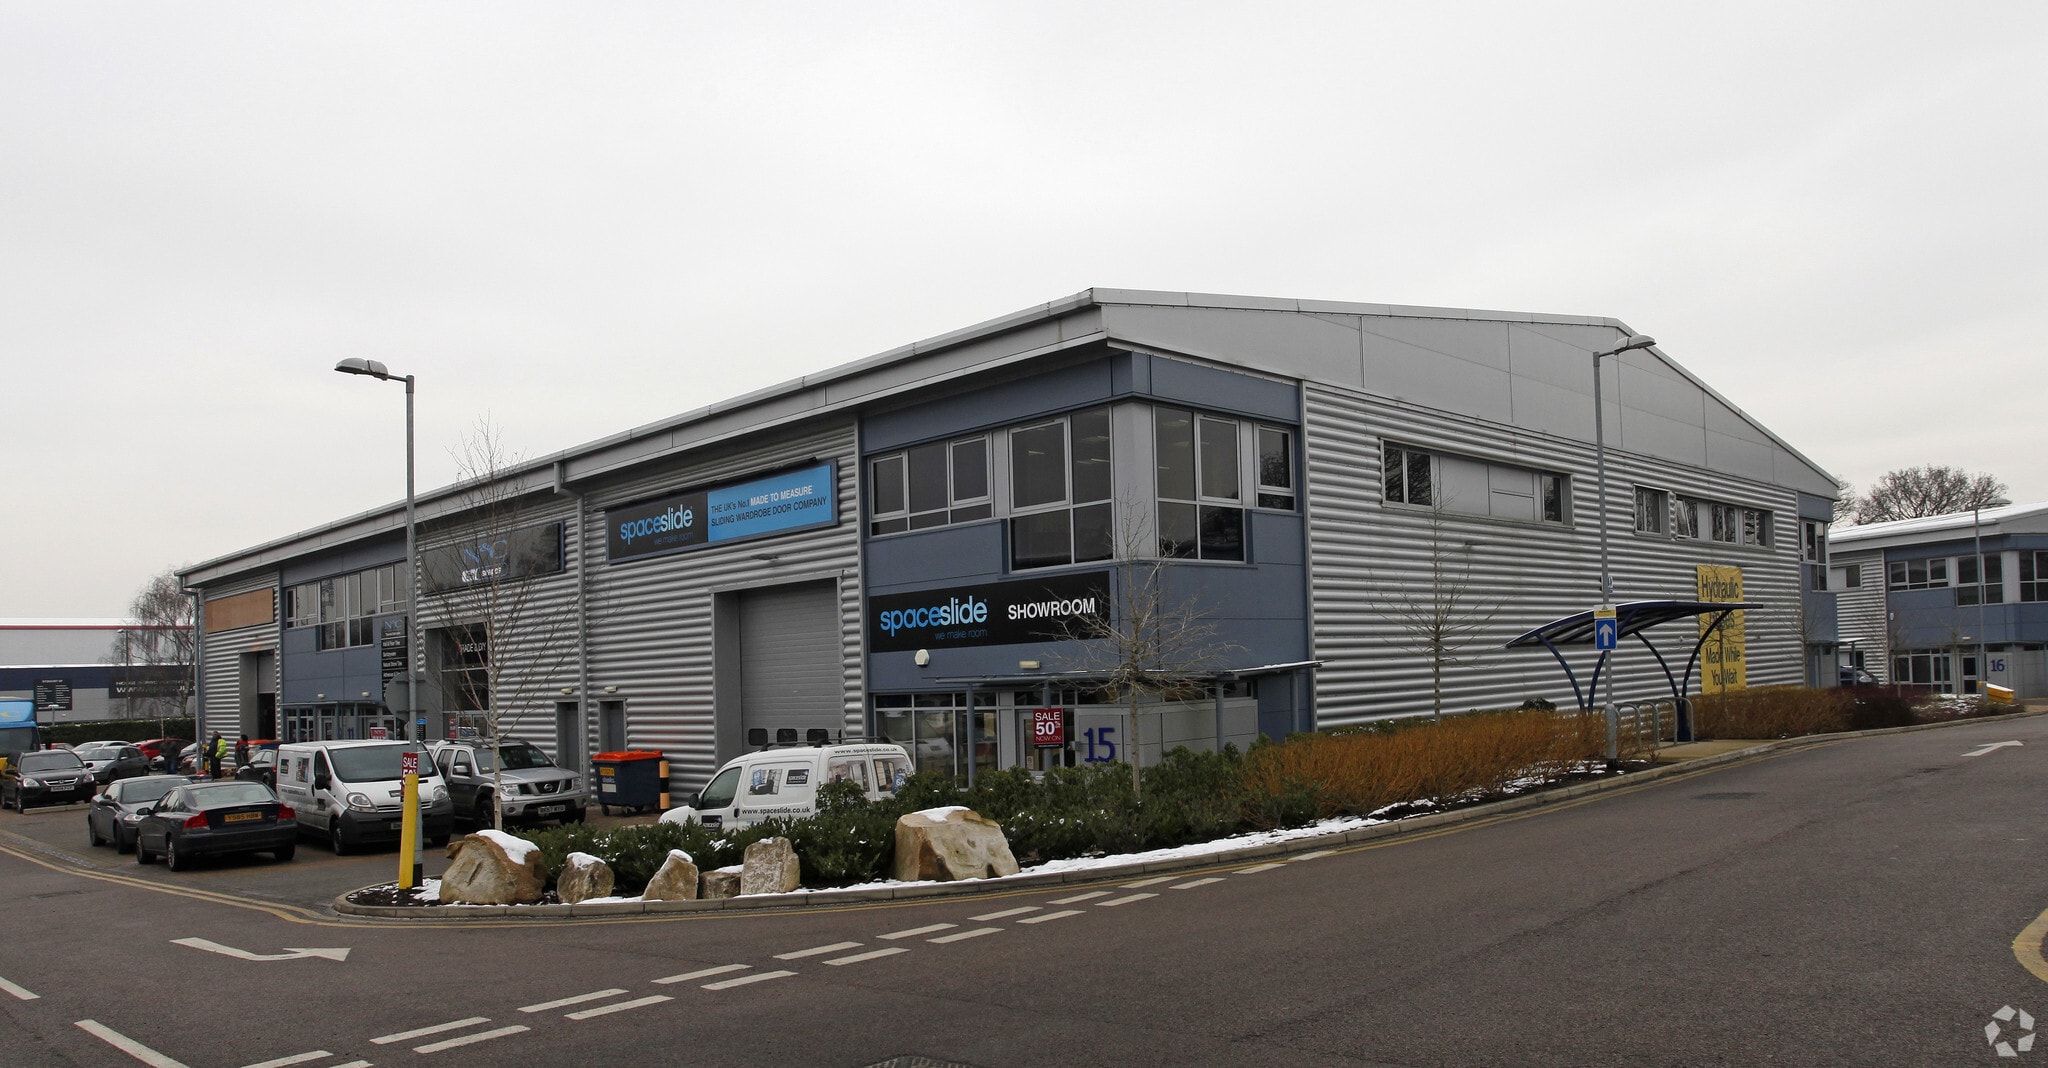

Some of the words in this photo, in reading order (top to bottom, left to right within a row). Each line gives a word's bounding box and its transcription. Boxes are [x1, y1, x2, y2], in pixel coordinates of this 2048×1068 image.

[711, 504, 722, 514] THE
[724, 502, 736, 511] UK's
[738, 499, 750, 509] No.1
[751, 494, 769, 506] MADE
[770, 492, 779, 502] TO
[781, 484, 813, 500] MEASURE
[711, 514, 735, 527] SLIDING
[736, 506, 771, 522] WARDROBE
[772, 503, 792, 515] DOOR
[793, 496, 827, 511] COMPANY
[620, 503, 693, 545] spaceslide
[1701, 574, 1739, 602] Hydraulic
[880, 595, 988, 637] spaceslide
[1007, 597, 1095, 620] SHOWROOM
[935, 632, 946, 640] we
[946, 630, 967, 639] make
[968, 628, 988, 638] room
[1724, 646, 1741, 663] While
[1990, 658, 2005, 672] 16
[1724, 668, 1738, 684] Wait
[1035, 711, 1060, 721] SALE
[1083, 727, 1116, 763] 15
[402, 756, 418, 769] SALE
[742, 806, 811, 815] www.spaceslide.co.uk
